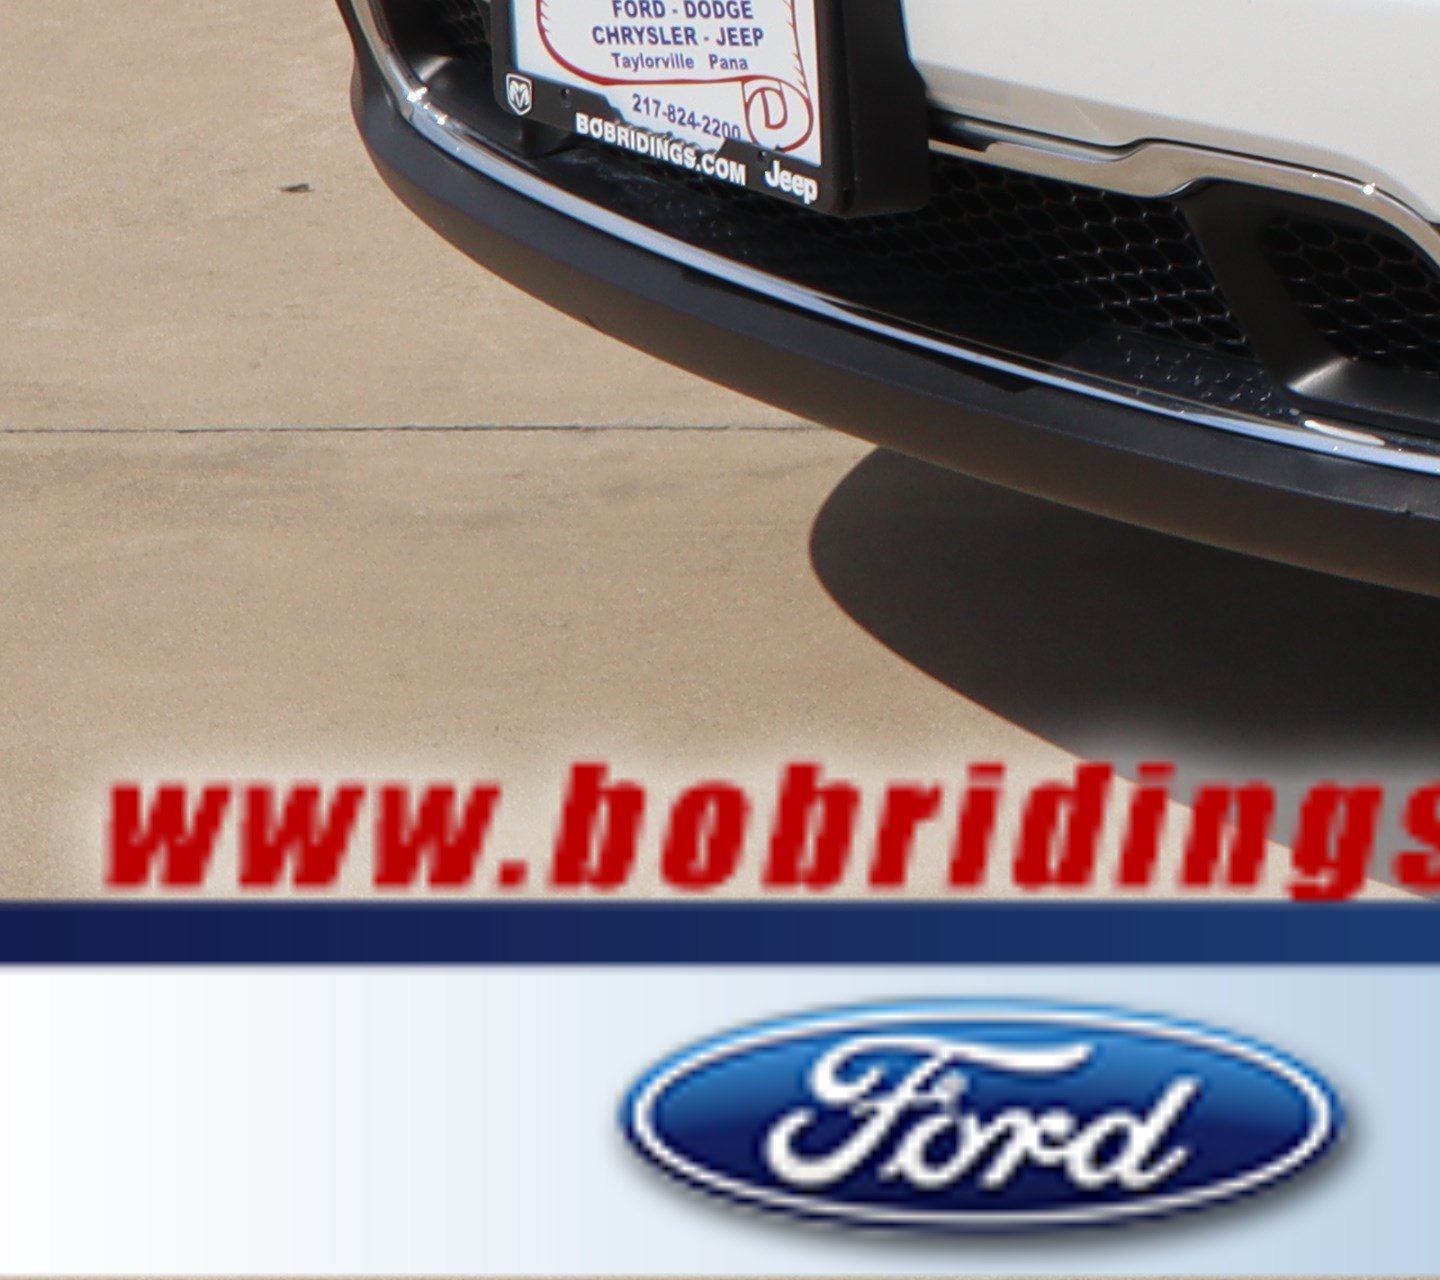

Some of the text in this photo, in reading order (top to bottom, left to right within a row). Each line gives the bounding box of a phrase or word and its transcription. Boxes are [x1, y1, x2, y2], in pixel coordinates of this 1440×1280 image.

[611, 0, 666, 19] FORD
[683, 0, 754, 20] DODGE
[591, 25, 699, 46] CHRYSLER
[715, 27, 764, 47] JEEP
[611, 52, 749, 73] Taylorville Pana
[631, 92, 742, 140] 217-824-2200
[575, 112, 747, 187] BOBRIDINGS.COM
[764, 159, 819, 204] Jeep
